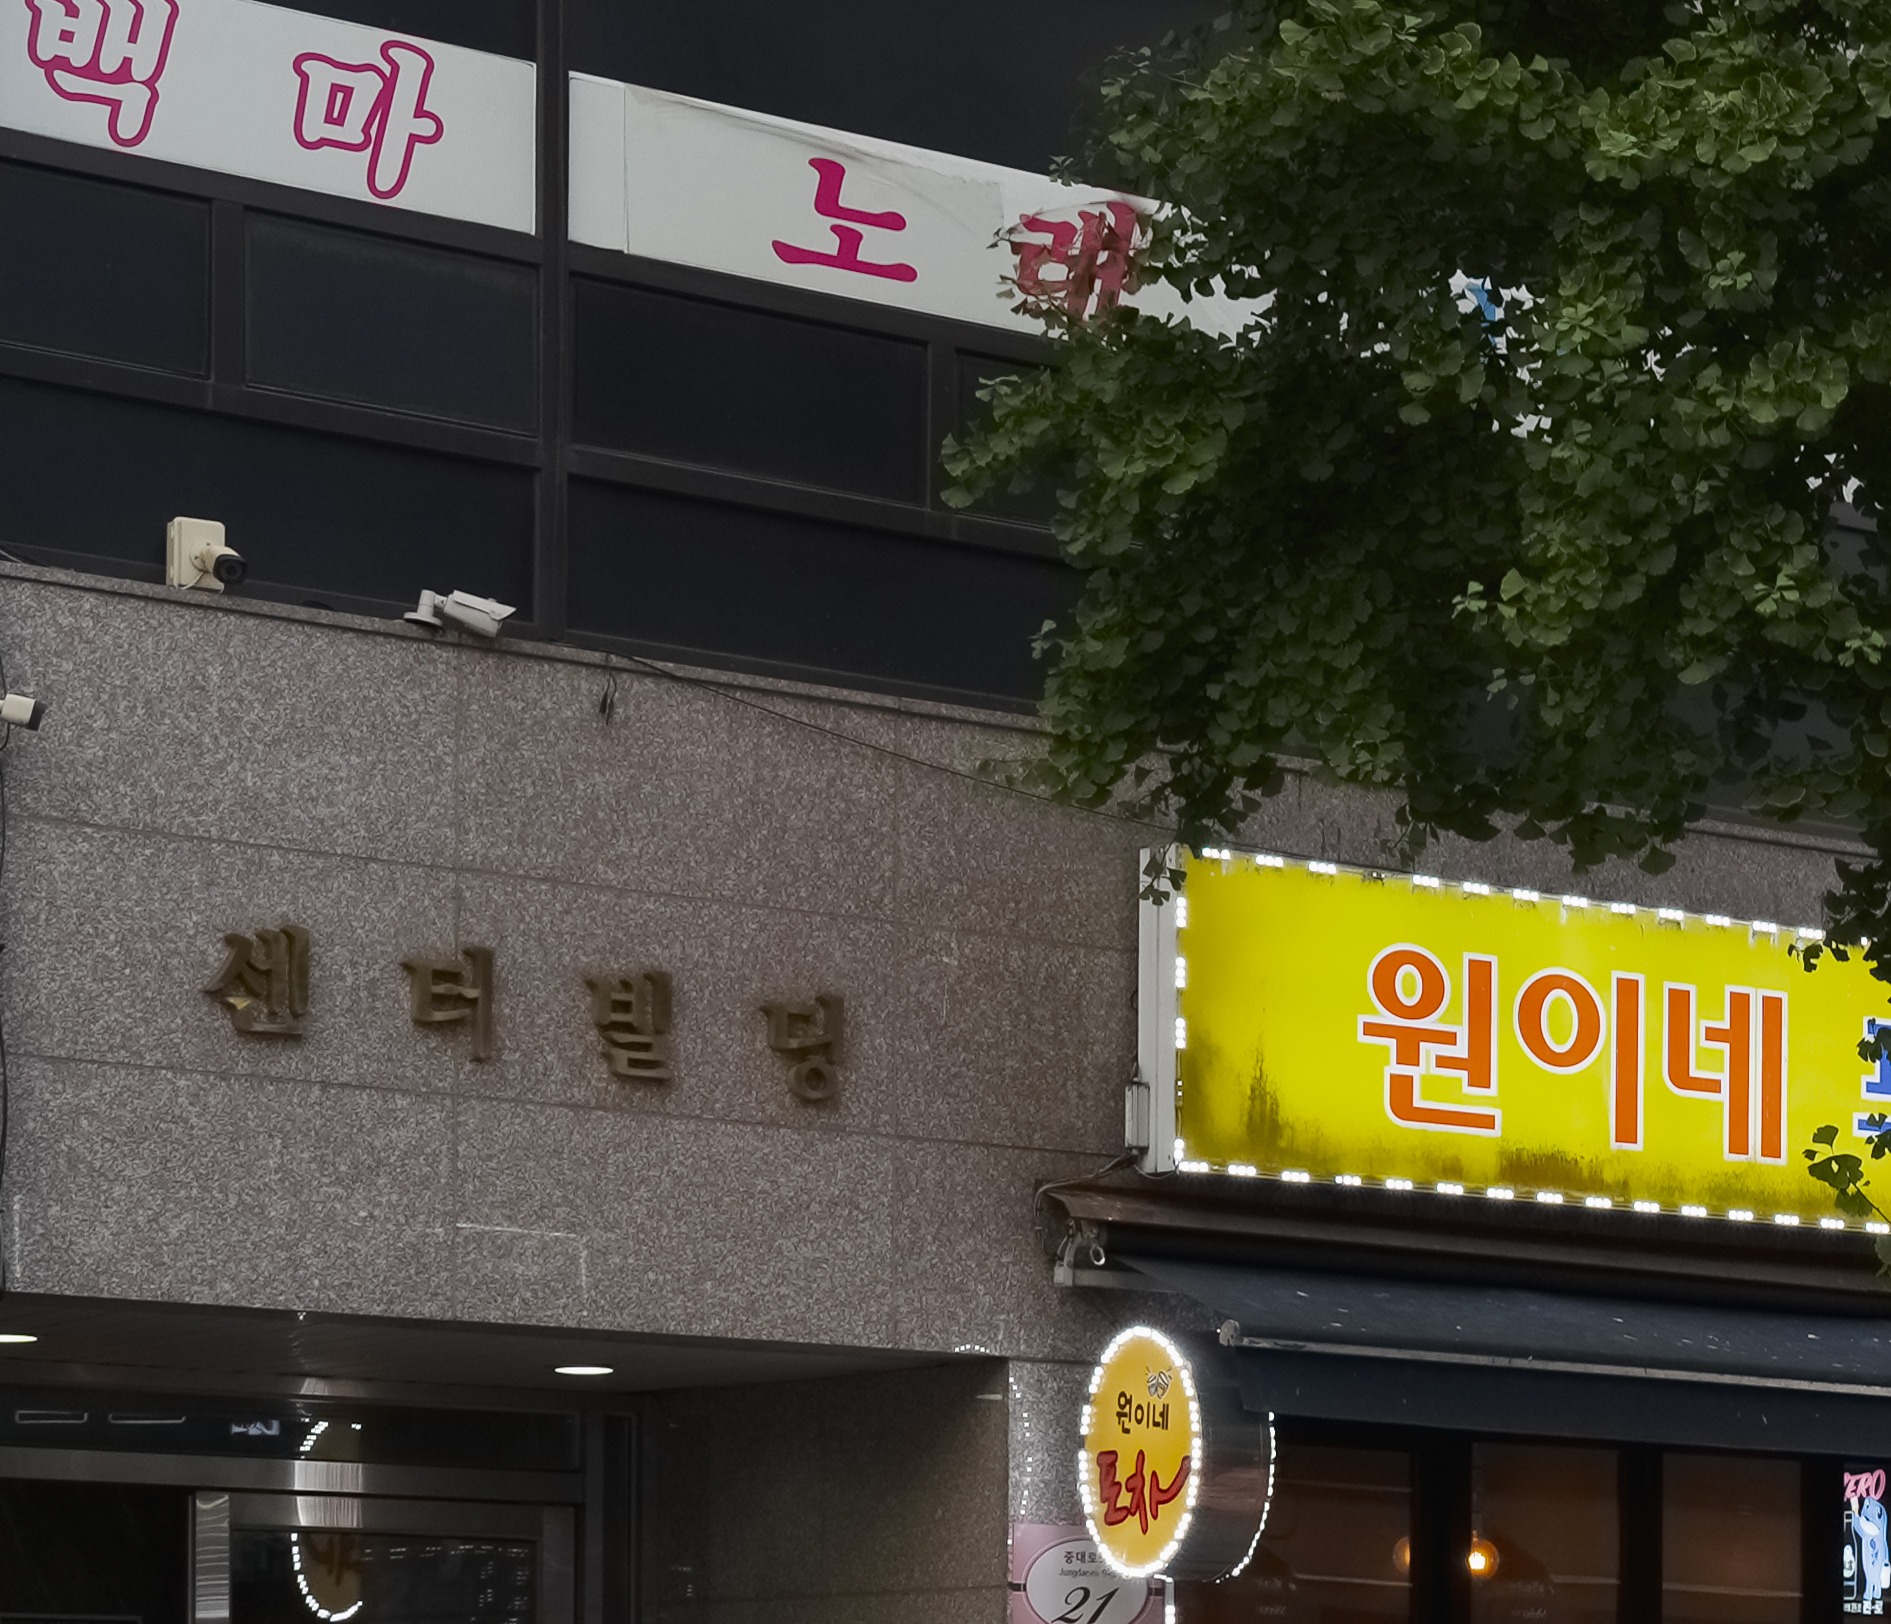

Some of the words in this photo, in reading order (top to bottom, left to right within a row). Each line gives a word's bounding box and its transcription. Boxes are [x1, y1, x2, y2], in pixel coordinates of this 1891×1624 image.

[204, 922, 846, 1102] 센터빌딩
[1358, 943, 1788, 1166] 원이네
[1116, 1391, 1169, 1434] 원이네
[1063, 1551, 1102, 1565] 중대로
[1050, 1586, 1120, 1624] 21
